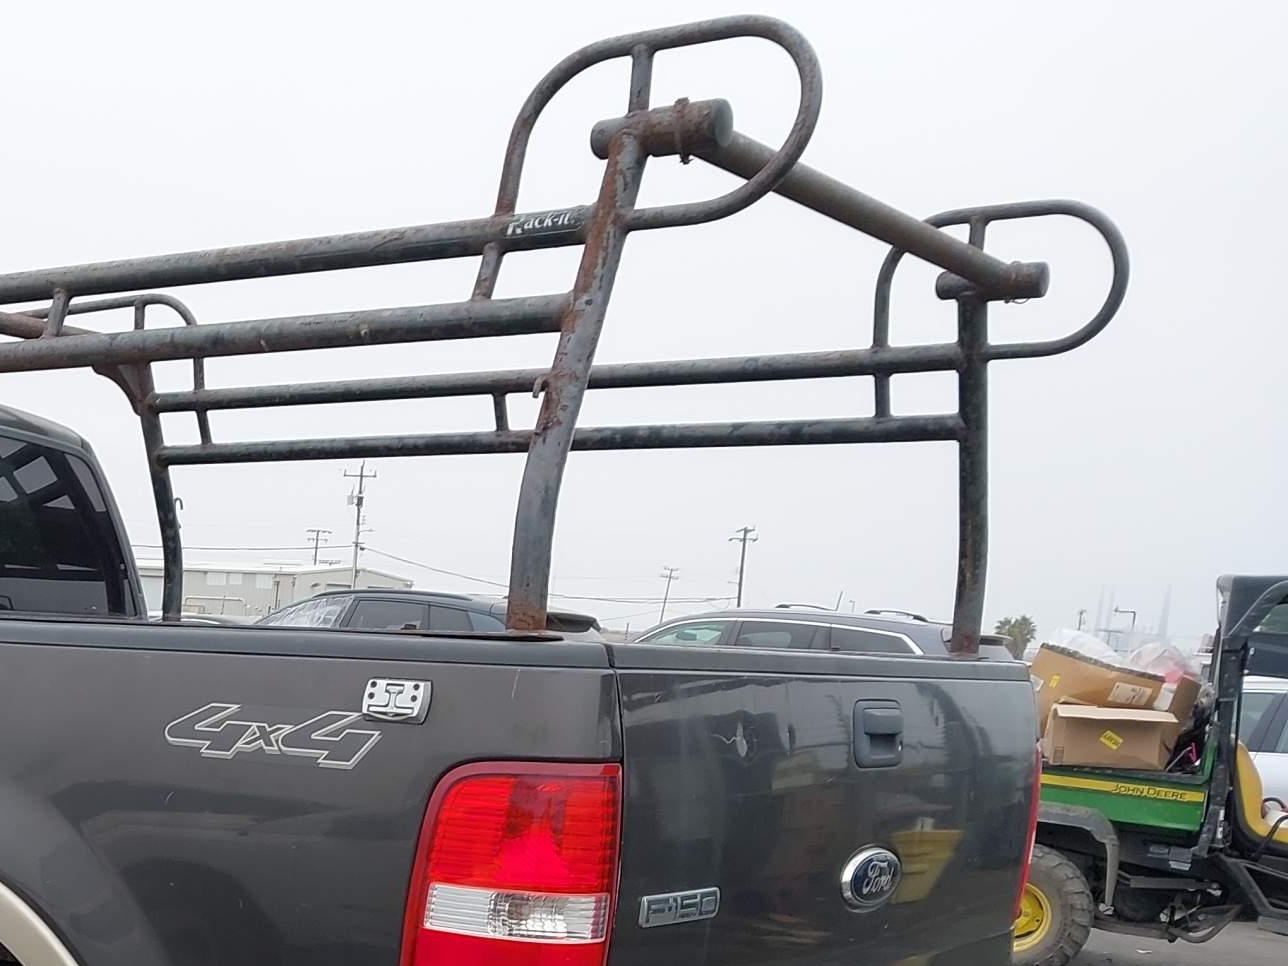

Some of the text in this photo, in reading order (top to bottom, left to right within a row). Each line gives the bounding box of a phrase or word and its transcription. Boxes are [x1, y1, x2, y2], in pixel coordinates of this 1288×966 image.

[164, 701, 382, 770] 4x4
[1111, 783, 1187, 801] JOHN DEERE
[862, 860, 895, 895] Ford
